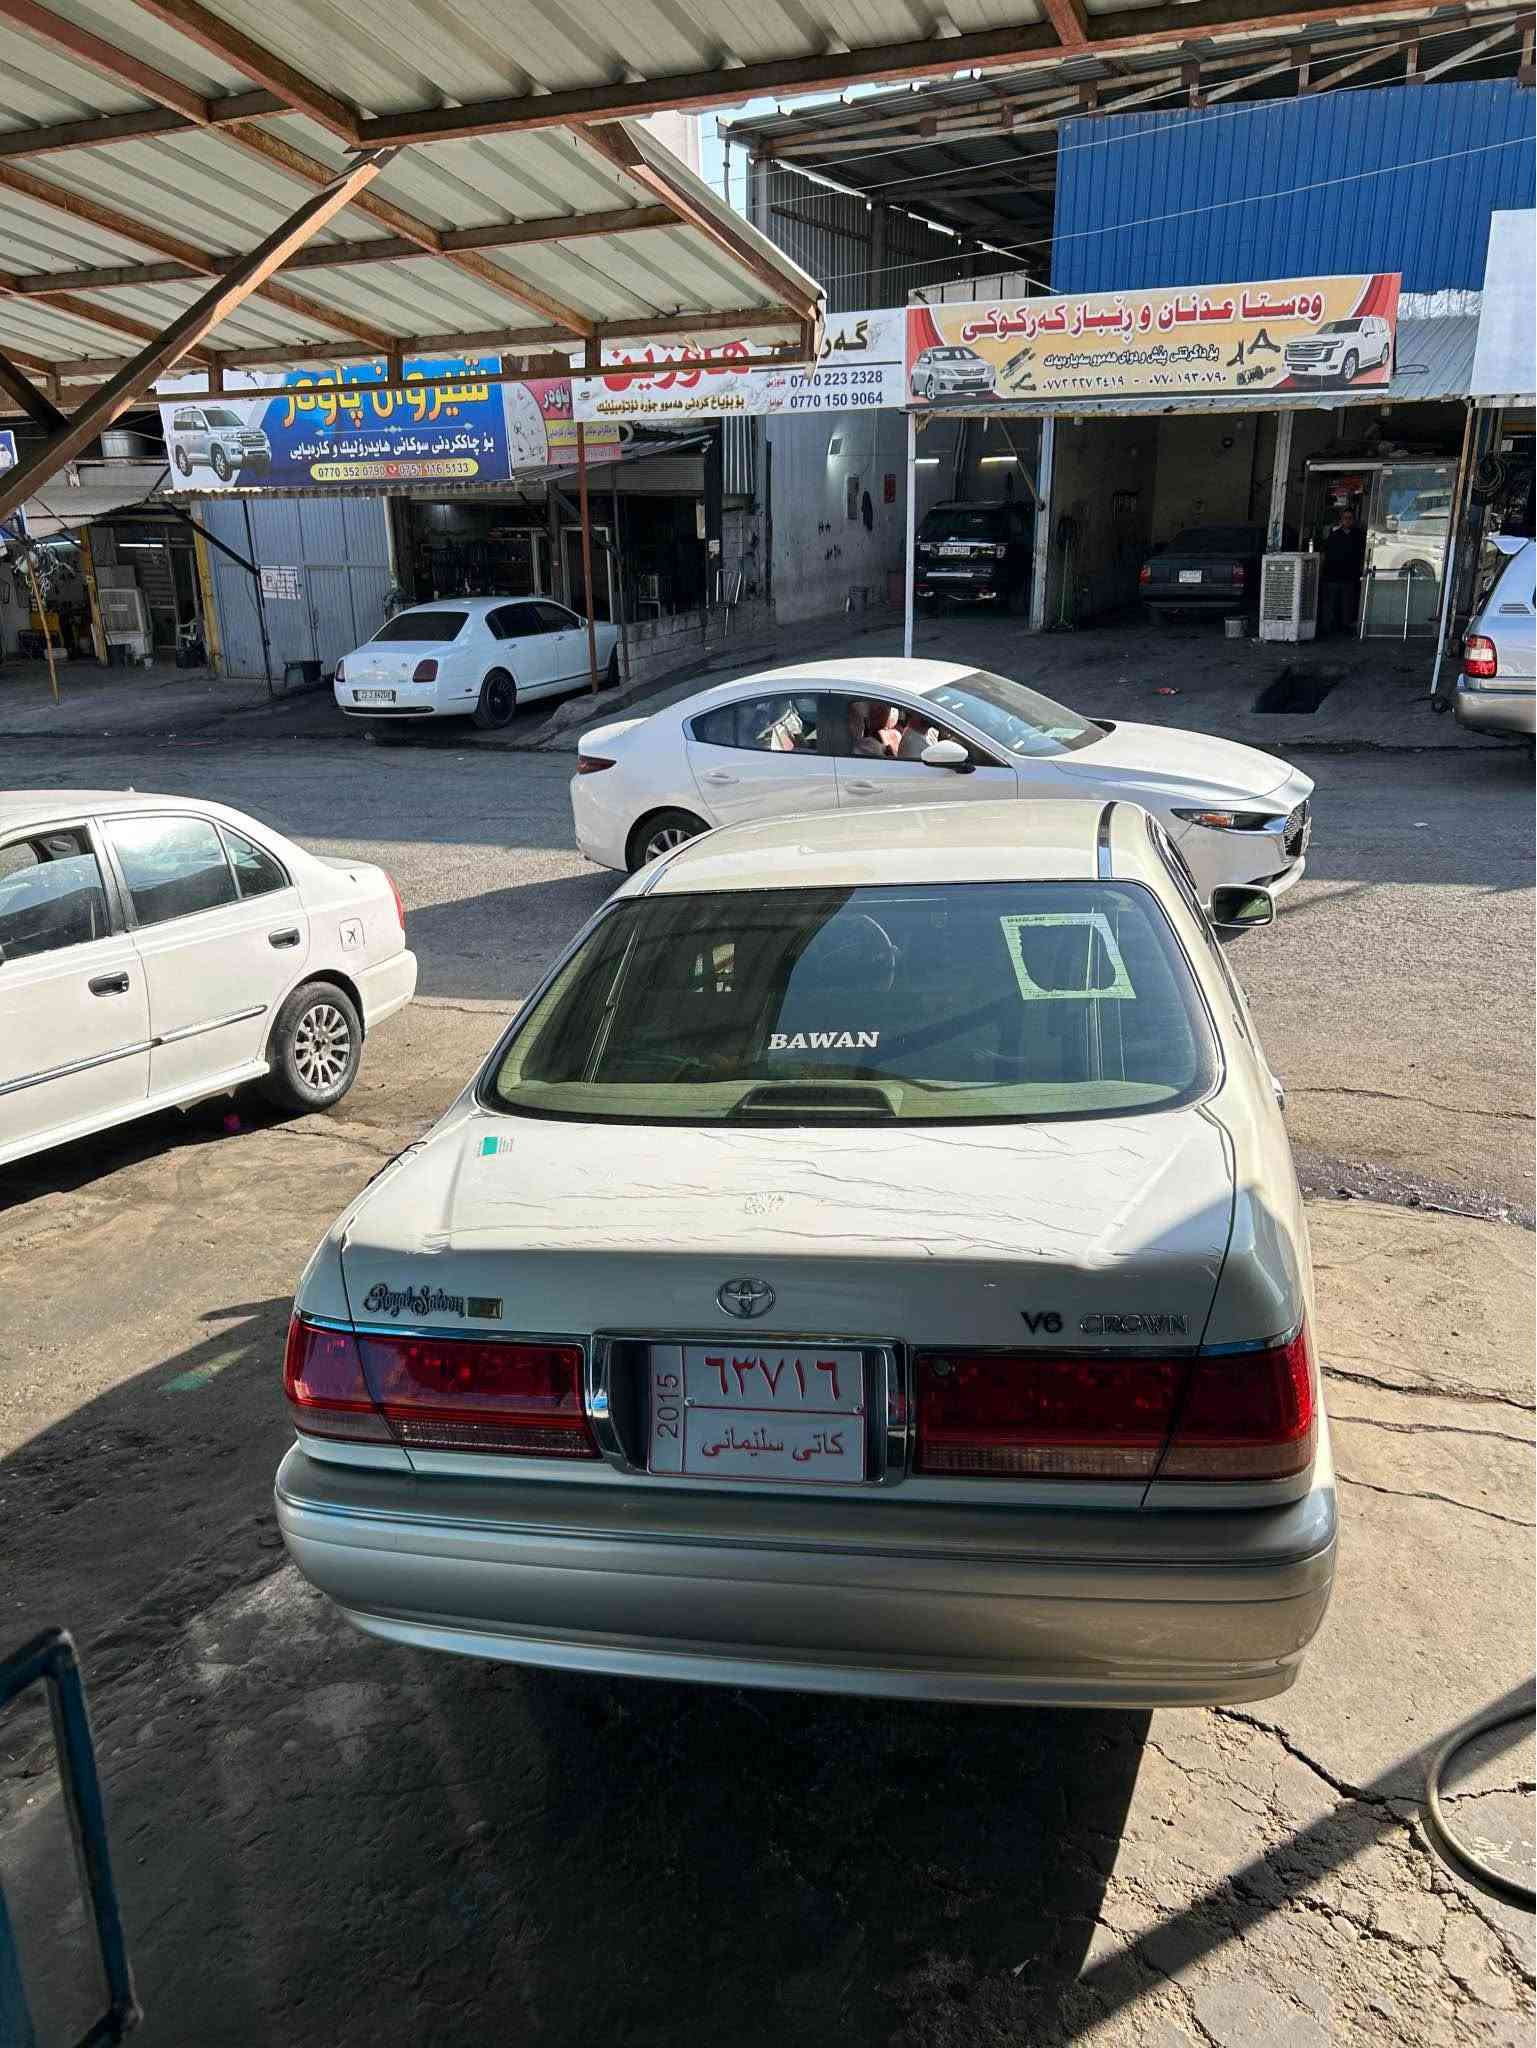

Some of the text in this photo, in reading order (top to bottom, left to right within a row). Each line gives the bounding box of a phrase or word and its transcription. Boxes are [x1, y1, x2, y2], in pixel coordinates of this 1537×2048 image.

[1158, 295, 1233, 330] عدنان
[1242, 292, 1323, 321] وەستا
[824, 371, 847, 386] 223
[851, 370, 883, 385] 2328
[790, 394, 821, 409] 0770
[825, 393, 848, 407] 150
[851, 391, 884, 406] 9064
[318, 467, 340, 478] 0770
[767, 1031, 880, 1050] BAWAN
[1020, 1311, 1190, 1337] V6 CROWN
[704, 1356, 840, 1401] ٦٣٧١٦
[656, 1374, 680, 1439] 2015
